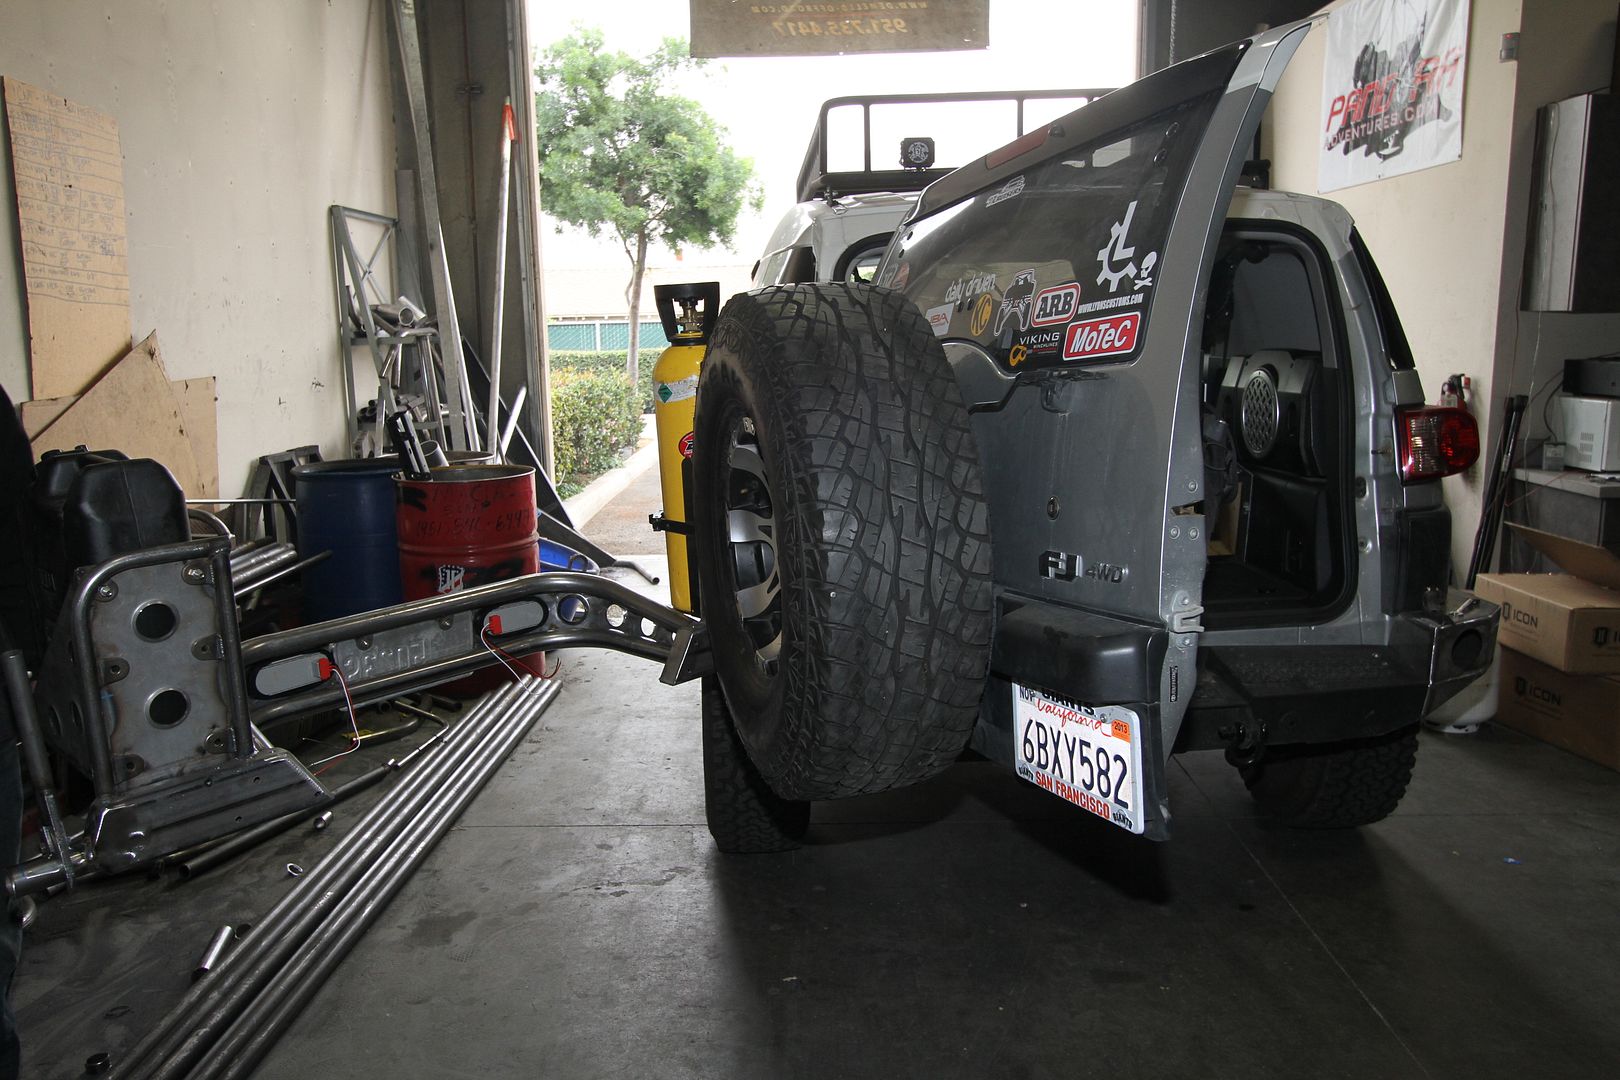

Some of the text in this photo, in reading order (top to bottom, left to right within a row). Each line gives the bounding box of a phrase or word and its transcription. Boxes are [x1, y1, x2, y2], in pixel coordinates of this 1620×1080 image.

[1036, 291, 1074, 319] ARB
[1020, 332, 1060, 345] VIKING
[1069, 320, 1132, 353] MoTeC
[1039, 550, 1083, 582] FJ
[1512, 609, 1538, 628] ICON
[1529, 685, 1561, 706] ICON
[1114, 721, 1128, 734] 2013
[1023, 719, 1129, 809] 6BXY582
[1035, 771, 1111, 820] SAN FRANCISCO
